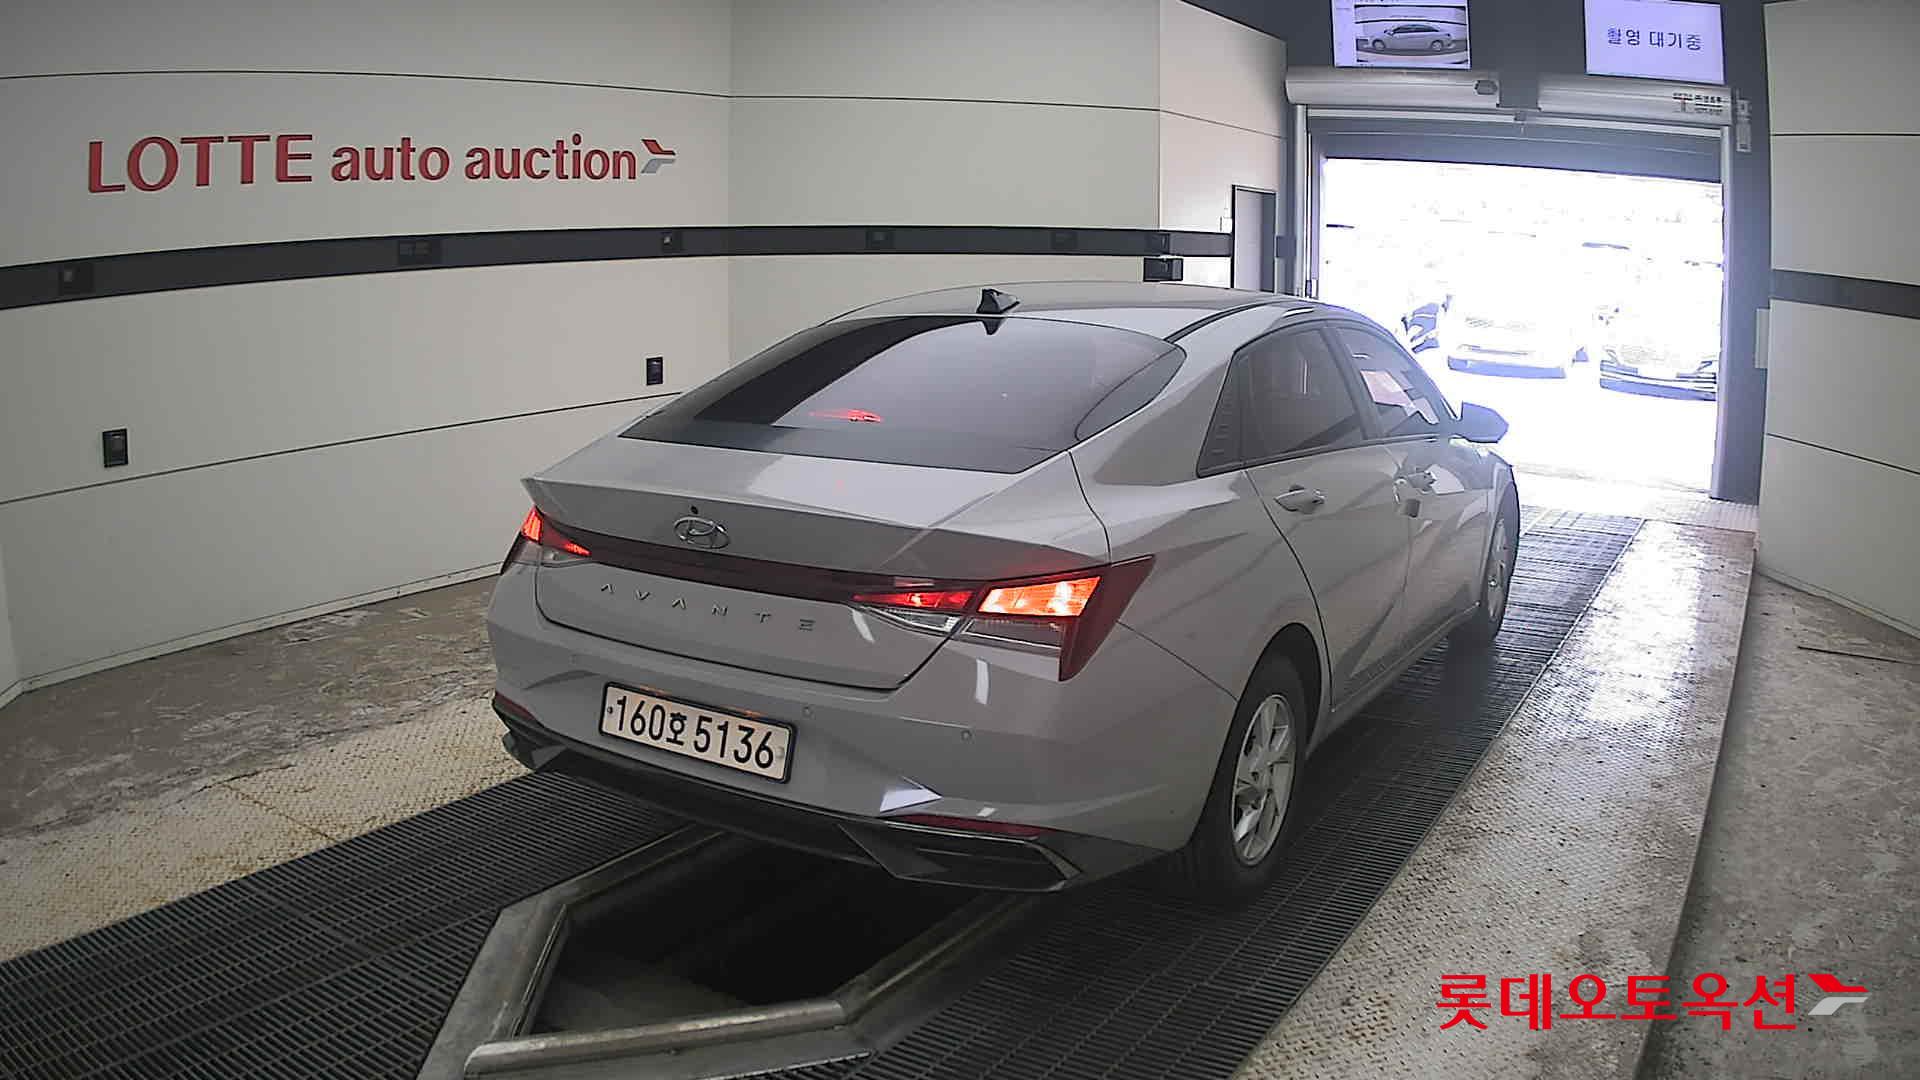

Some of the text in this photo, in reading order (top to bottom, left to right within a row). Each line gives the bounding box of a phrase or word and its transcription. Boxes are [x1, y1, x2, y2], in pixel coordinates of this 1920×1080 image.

[1648, 31, 1702, 52] 대기중
[88, 132, 638, 194] LOTTE auto auction
[600, 582, 816, 632] AVANTE
